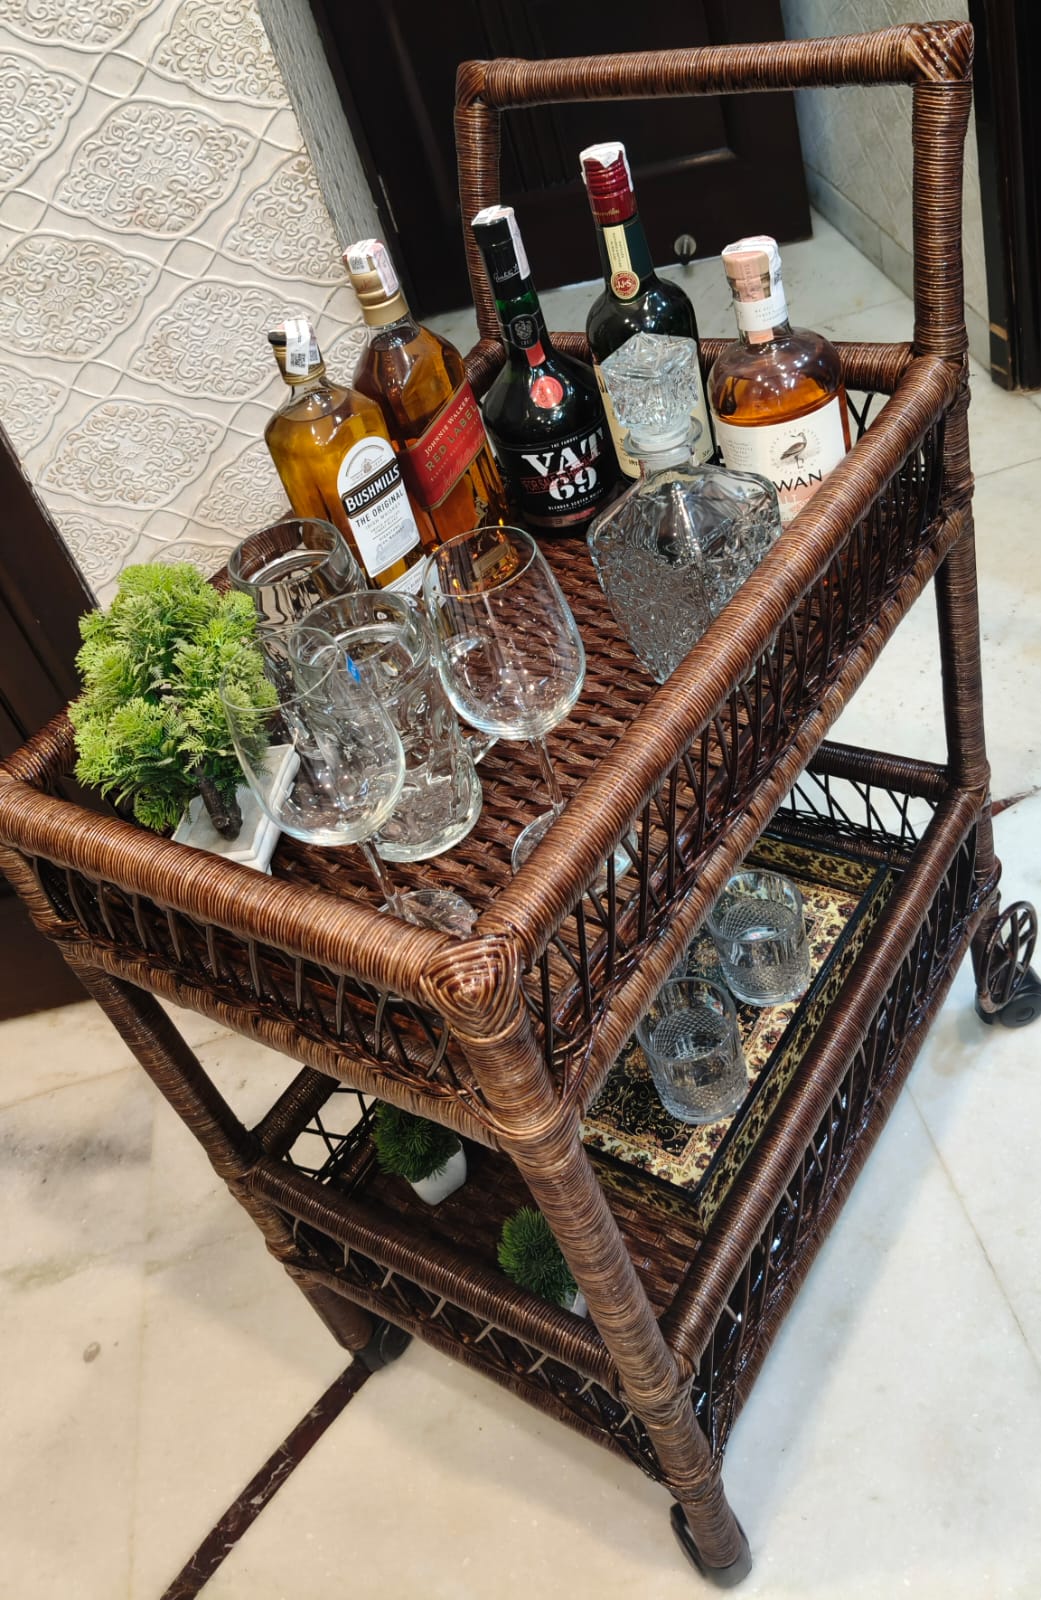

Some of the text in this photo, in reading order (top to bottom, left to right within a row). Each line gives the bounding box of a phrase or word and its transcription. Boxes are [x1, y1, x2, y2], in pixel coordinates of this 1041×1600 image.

[424, 425, 449, 457] JOHNNIE
[425, 445, 447, 471] RED
[447, 405, 478, 443] LABEL
[521, 426, 604, 477] VAT
[344, 463, 402, 513] BUSHMILLS
[549, 466, 597, 500] 69
[772, 468, 823, 493] WAN
[355, 514, 371, 528] THE
[371, 491, 404, 518] ORIGINAL
